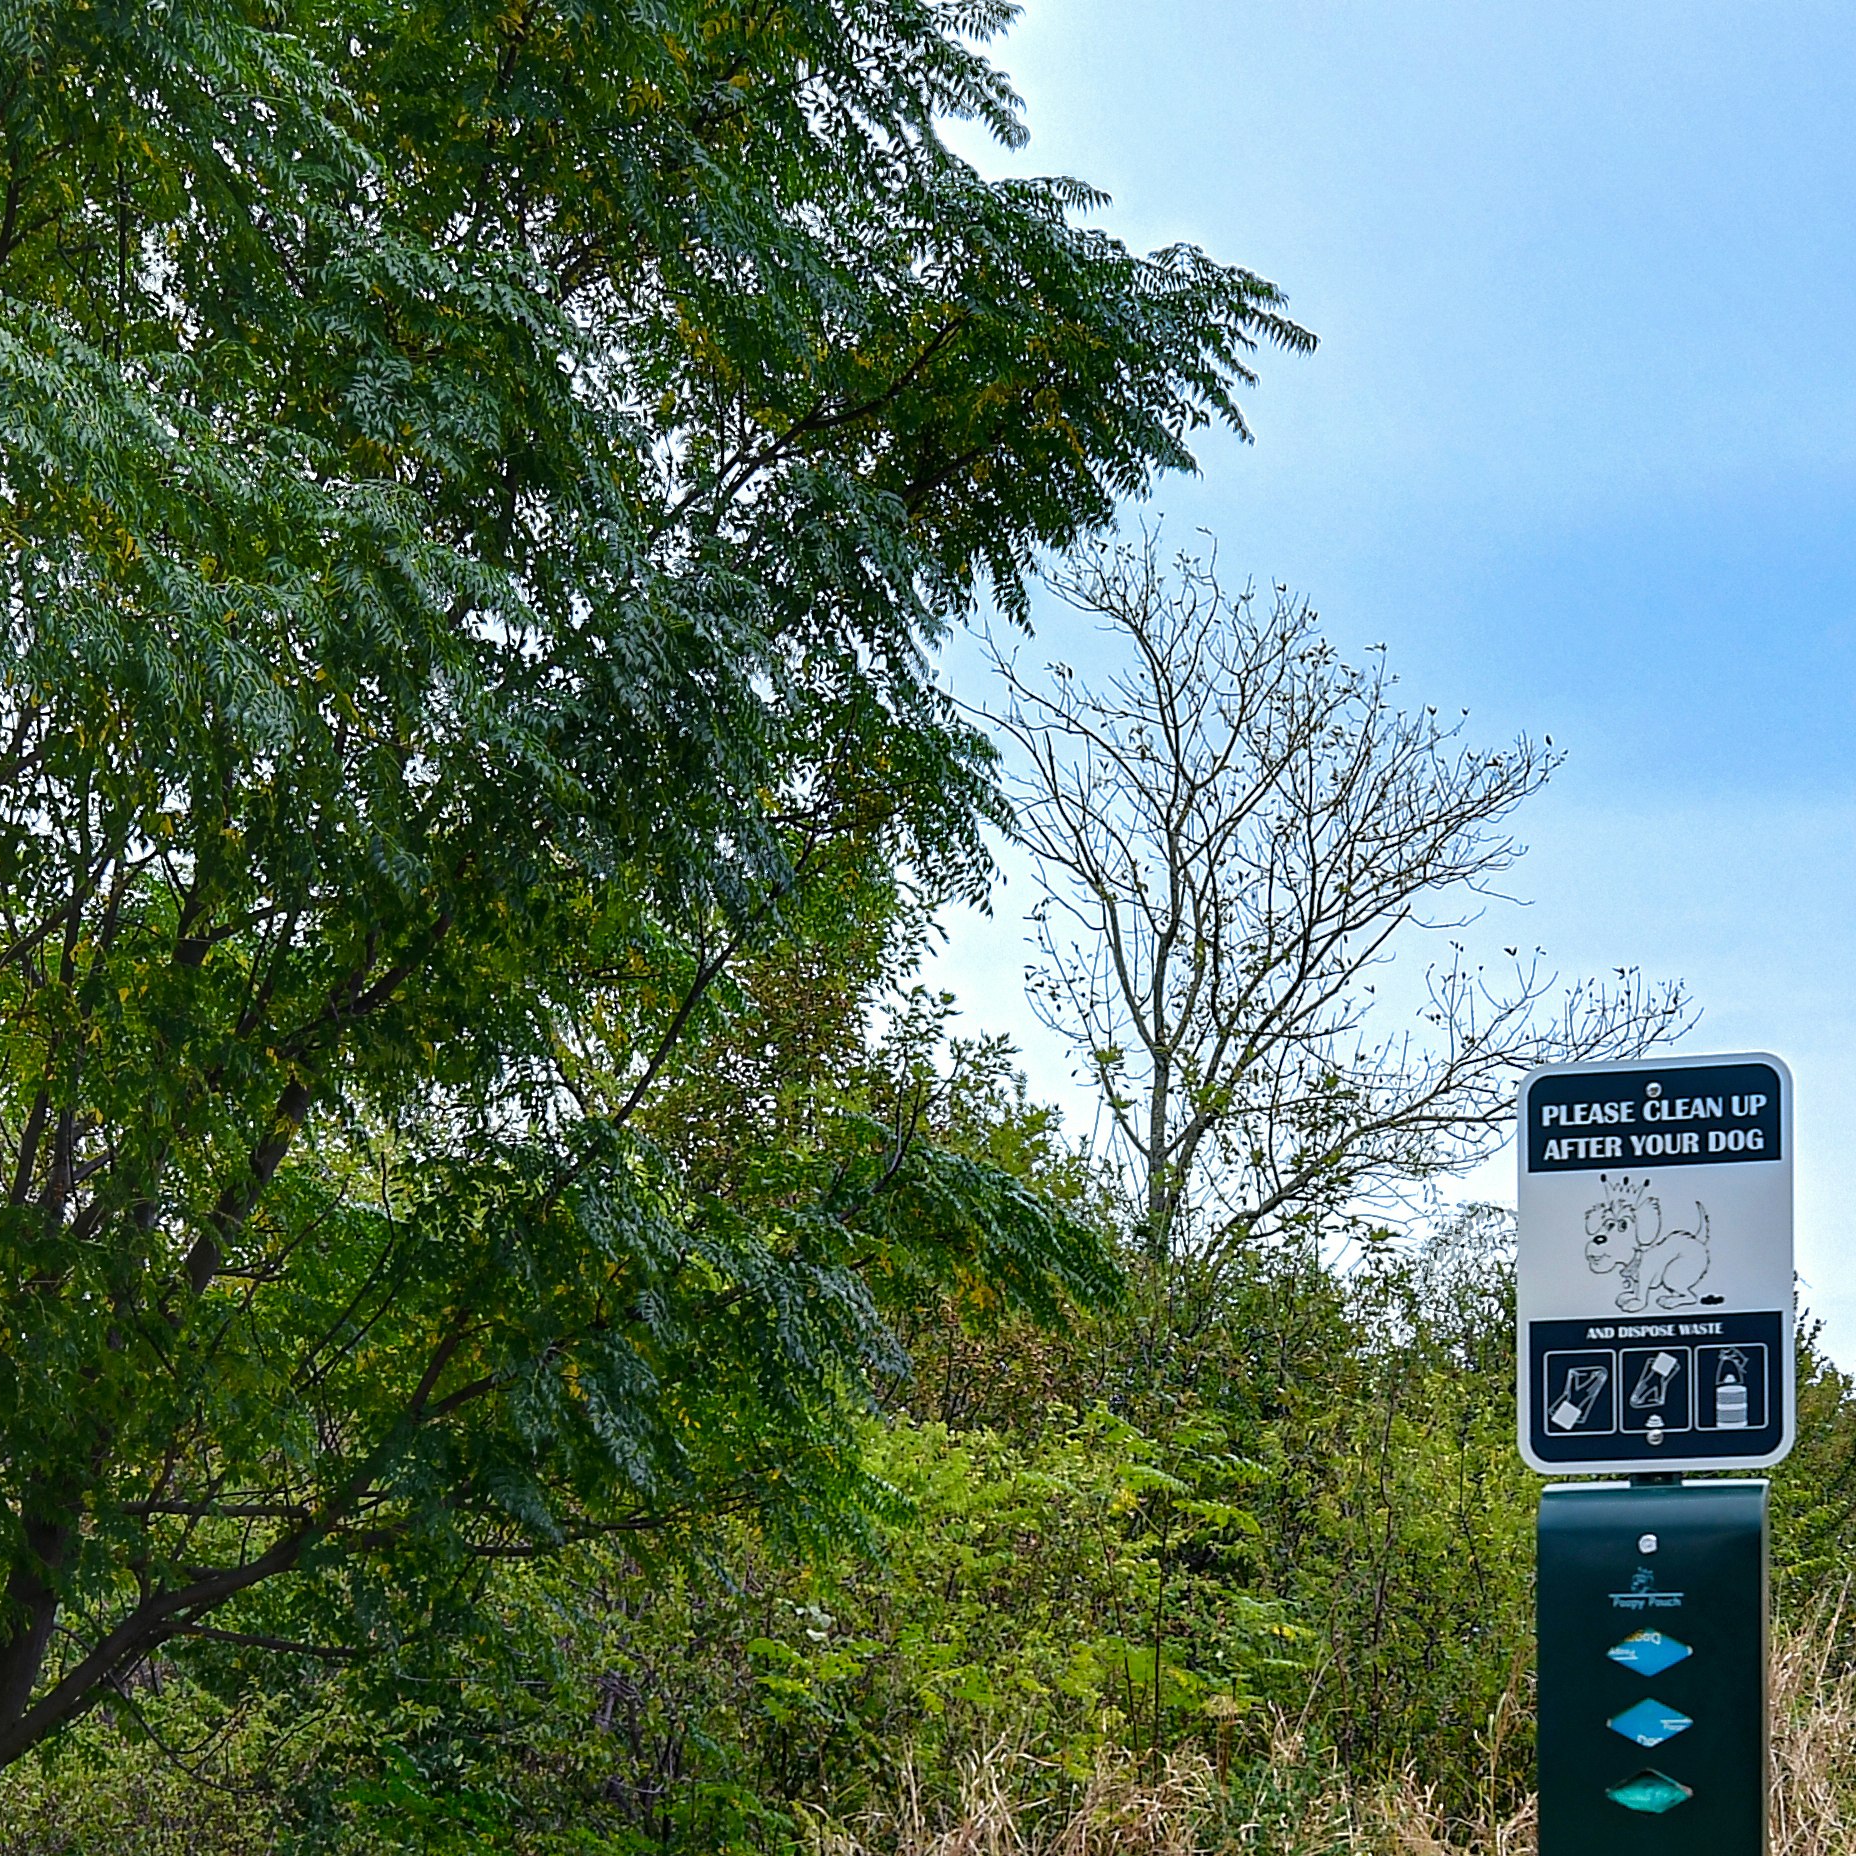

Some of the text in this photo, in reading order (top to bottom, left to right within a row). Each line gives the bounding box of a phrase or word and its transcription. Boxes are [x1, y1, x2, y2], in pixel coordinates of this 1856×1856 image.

[1541, 1094, 1767, 1127] PLEASE CLEAN UP
[1544, 1129, 1764, 1160] AFTER YOUR DOG
[1586, 1322, 1724, 1340] AND DISPOSE WASTE
